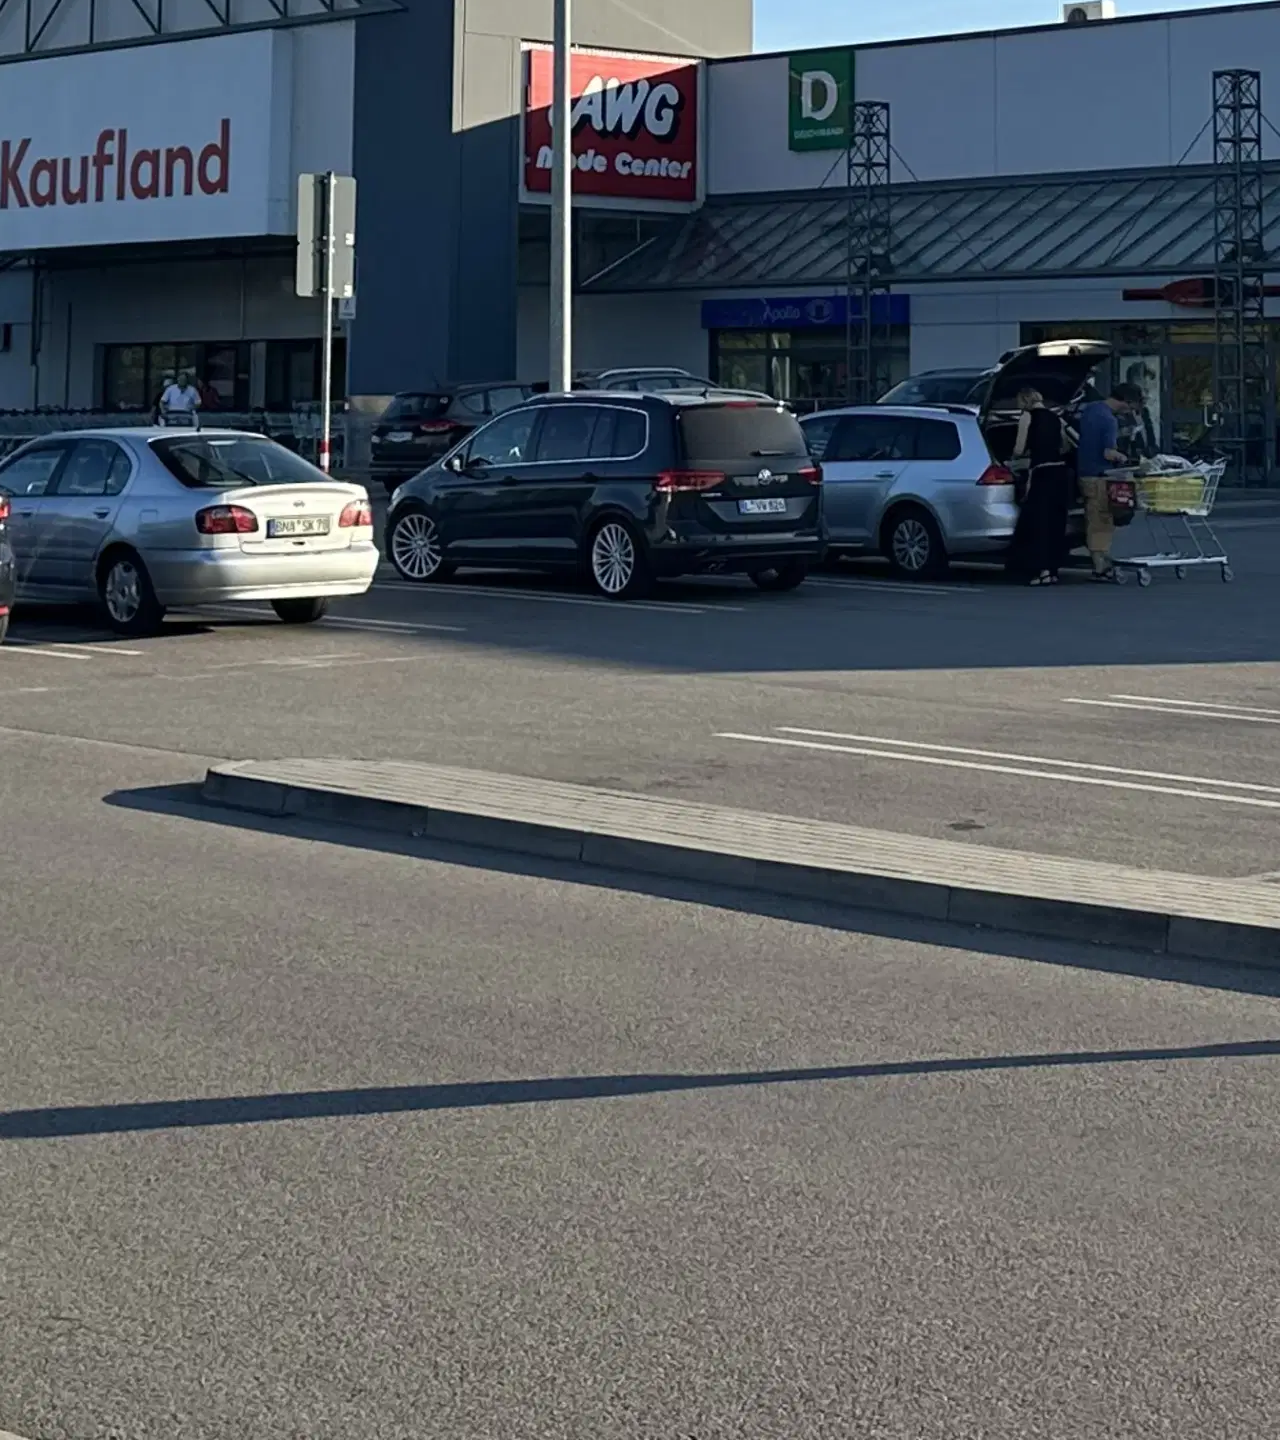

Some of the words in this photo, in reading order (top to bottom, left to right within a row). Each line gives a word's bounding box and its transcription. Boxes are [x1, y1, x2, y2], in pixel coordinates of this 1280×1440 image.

[548, 75, 679, 136] AWG
[801, 69, 839, 121] D
[0, 117, 232, 212] Kaufland
[614, 151, 692, 179] Center
